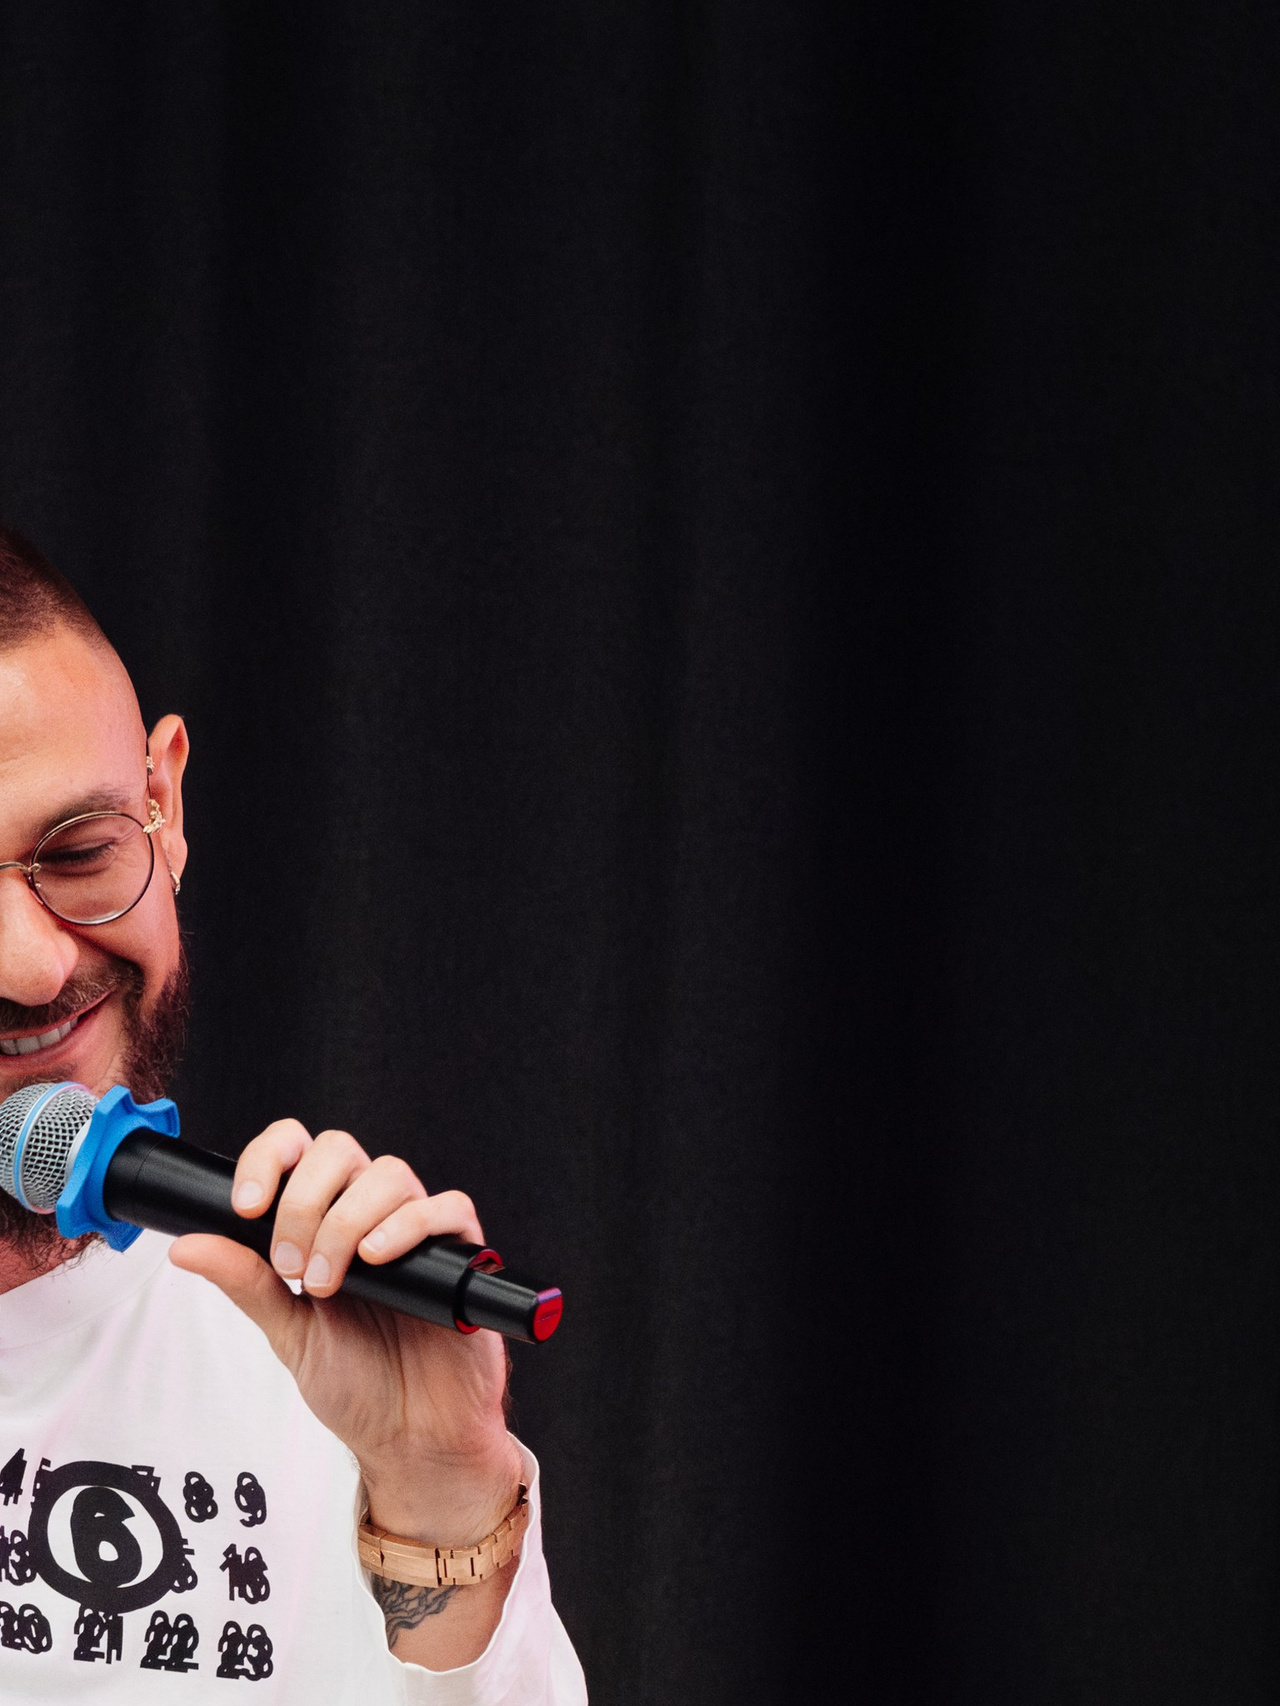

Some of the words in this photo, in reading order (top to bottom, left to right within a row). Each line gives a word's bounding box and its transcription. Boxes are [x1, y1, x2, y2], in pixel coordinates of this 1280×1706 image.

[70, 1485, 143, 1586] 6
[182, 1471, 219, 1523] 8
[234, 1471, 267, 1528] 9
[73, 1603, 124, 1664] 21
[139, 1609, 200, 1674] 22
[216, 1620, 274, 1682] 23
